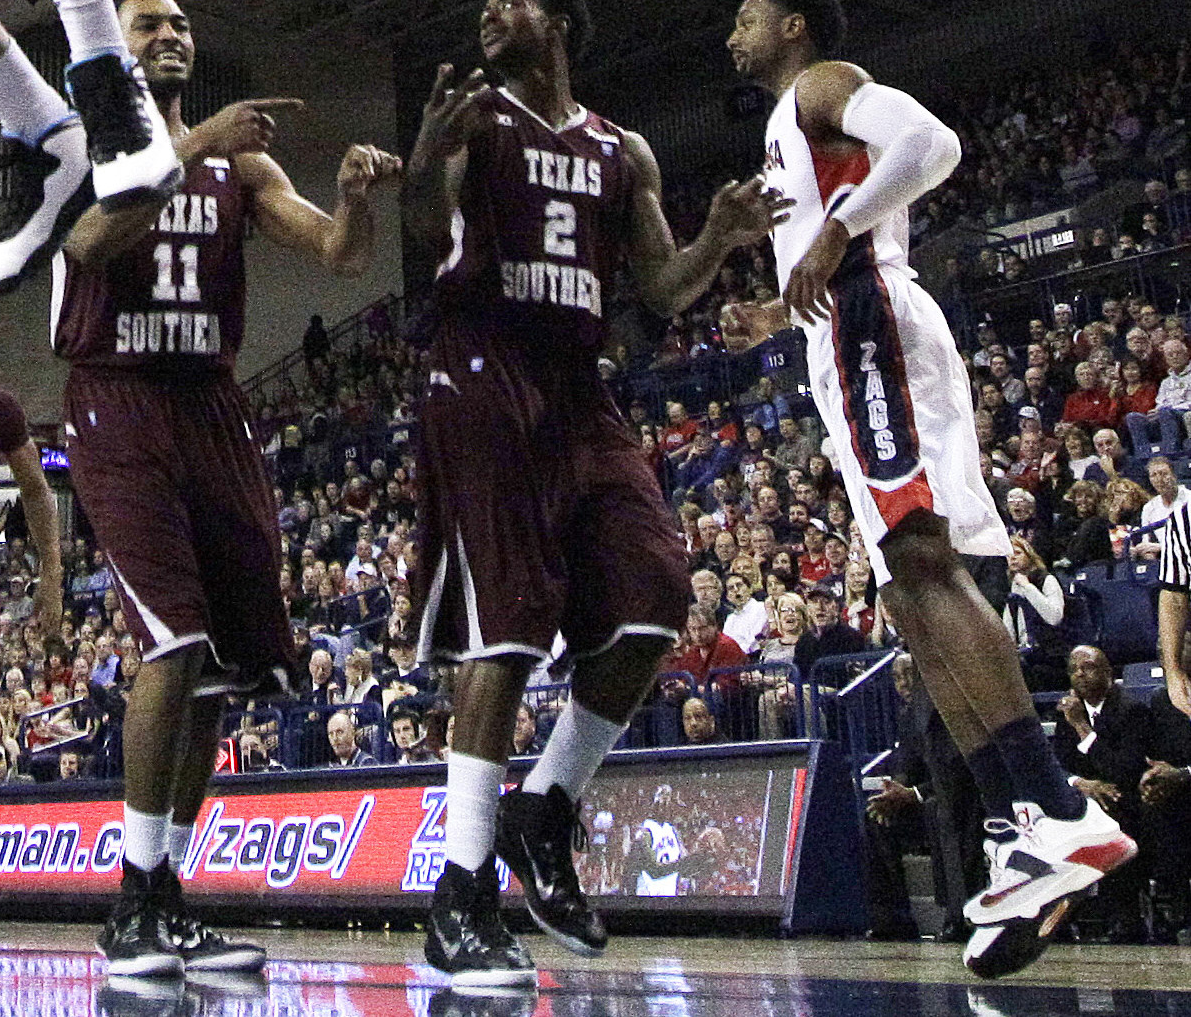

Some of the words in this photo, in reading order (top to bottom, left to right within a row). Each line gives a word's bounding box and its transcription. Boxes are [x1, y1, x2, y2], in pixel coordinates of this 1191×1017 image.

[523, 148, 602, 197] TEXAS
[150, 193, 219, 233] EXAS
[544, 200, 577, 258] 2
[152, 243, 202, 302] 11
[768, 353, 785, 368] 113
[859, 340, 898, 462] ZAGS
